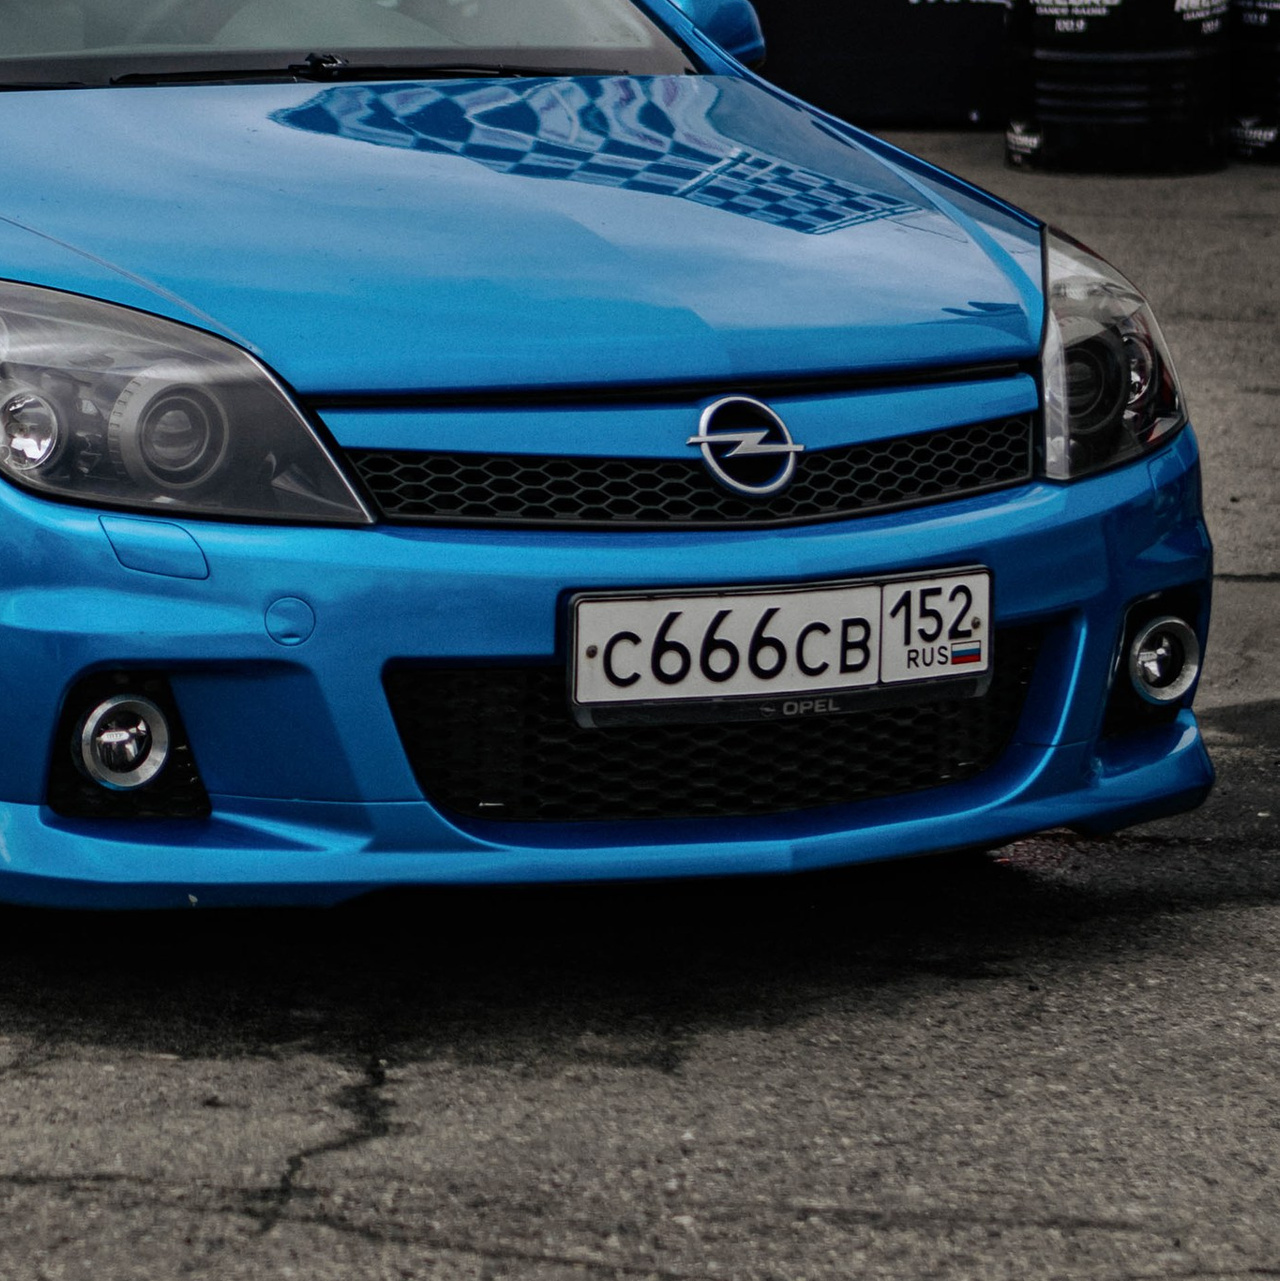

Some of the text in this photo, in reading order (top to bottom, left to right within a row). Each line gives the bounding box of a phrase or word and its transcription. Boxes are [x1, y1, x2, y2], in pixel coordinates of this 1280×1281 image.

[890, 584, 973, 647] 152
[906, 648, 950, 670] RUS
[782, 698, 842, 716] OPEL
